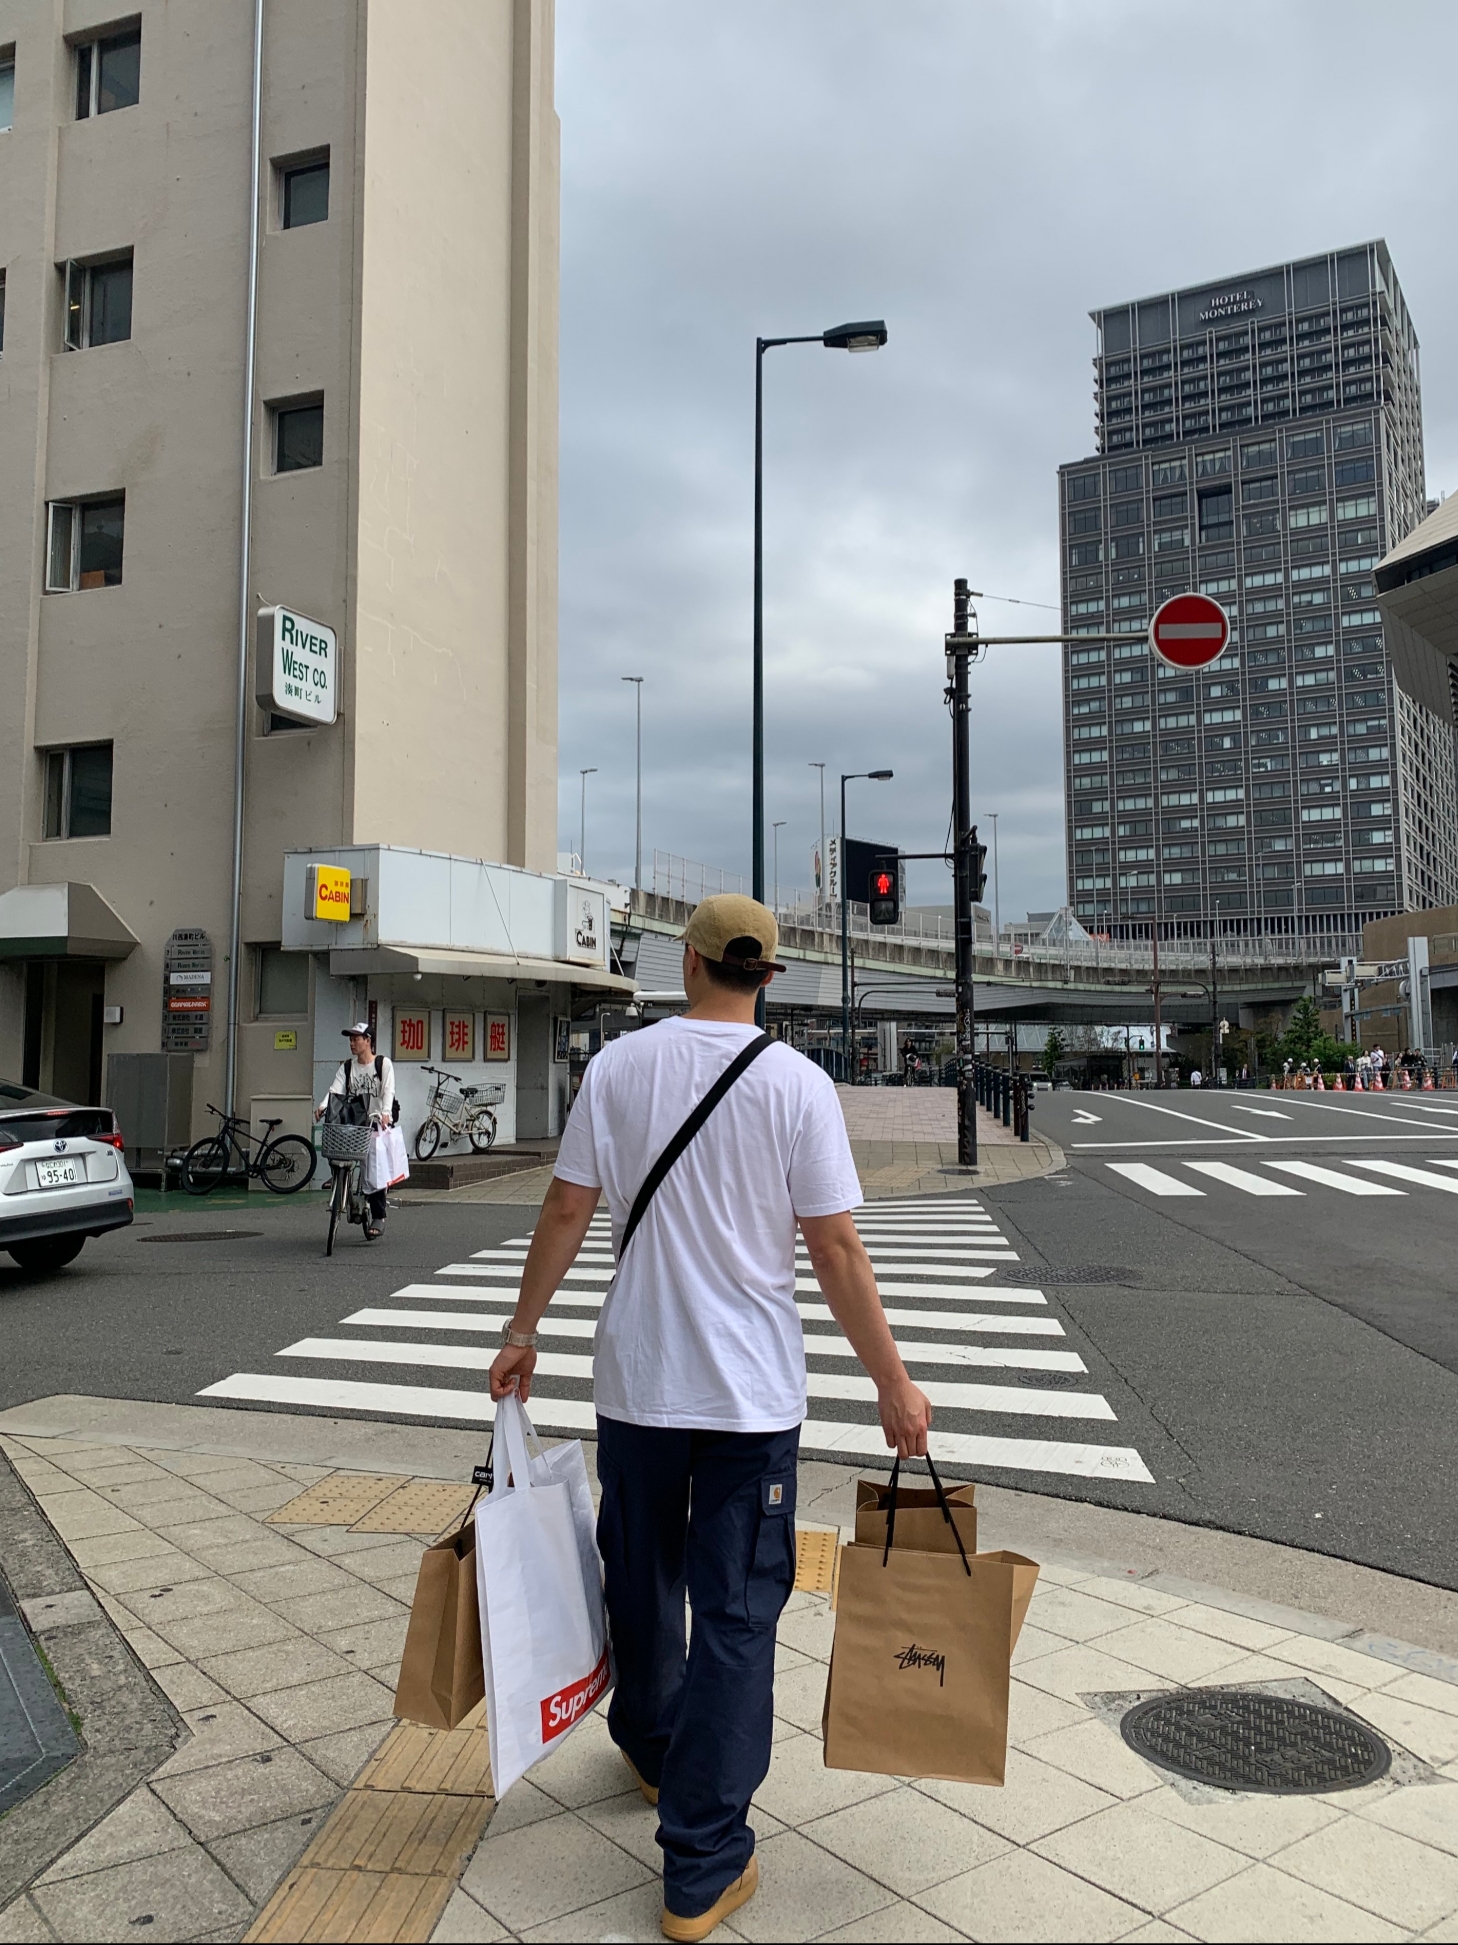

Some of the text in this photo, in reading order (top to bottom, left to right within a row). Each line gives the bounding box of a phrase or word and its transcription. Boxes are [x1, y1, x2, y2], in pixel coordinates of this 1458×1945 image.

[1200, 298, 1264, 320] MONTEREY
[1211, 290, 1251, 307] HOTEL
[282, 614, 328, 658] RIVER
[282, 647, 327, 690] WEST CO.
[319, 883, 349, 904] CABIN
[577, 930, 596, 949] CABIN
[47, 1168, 74, 1183] 95-40
